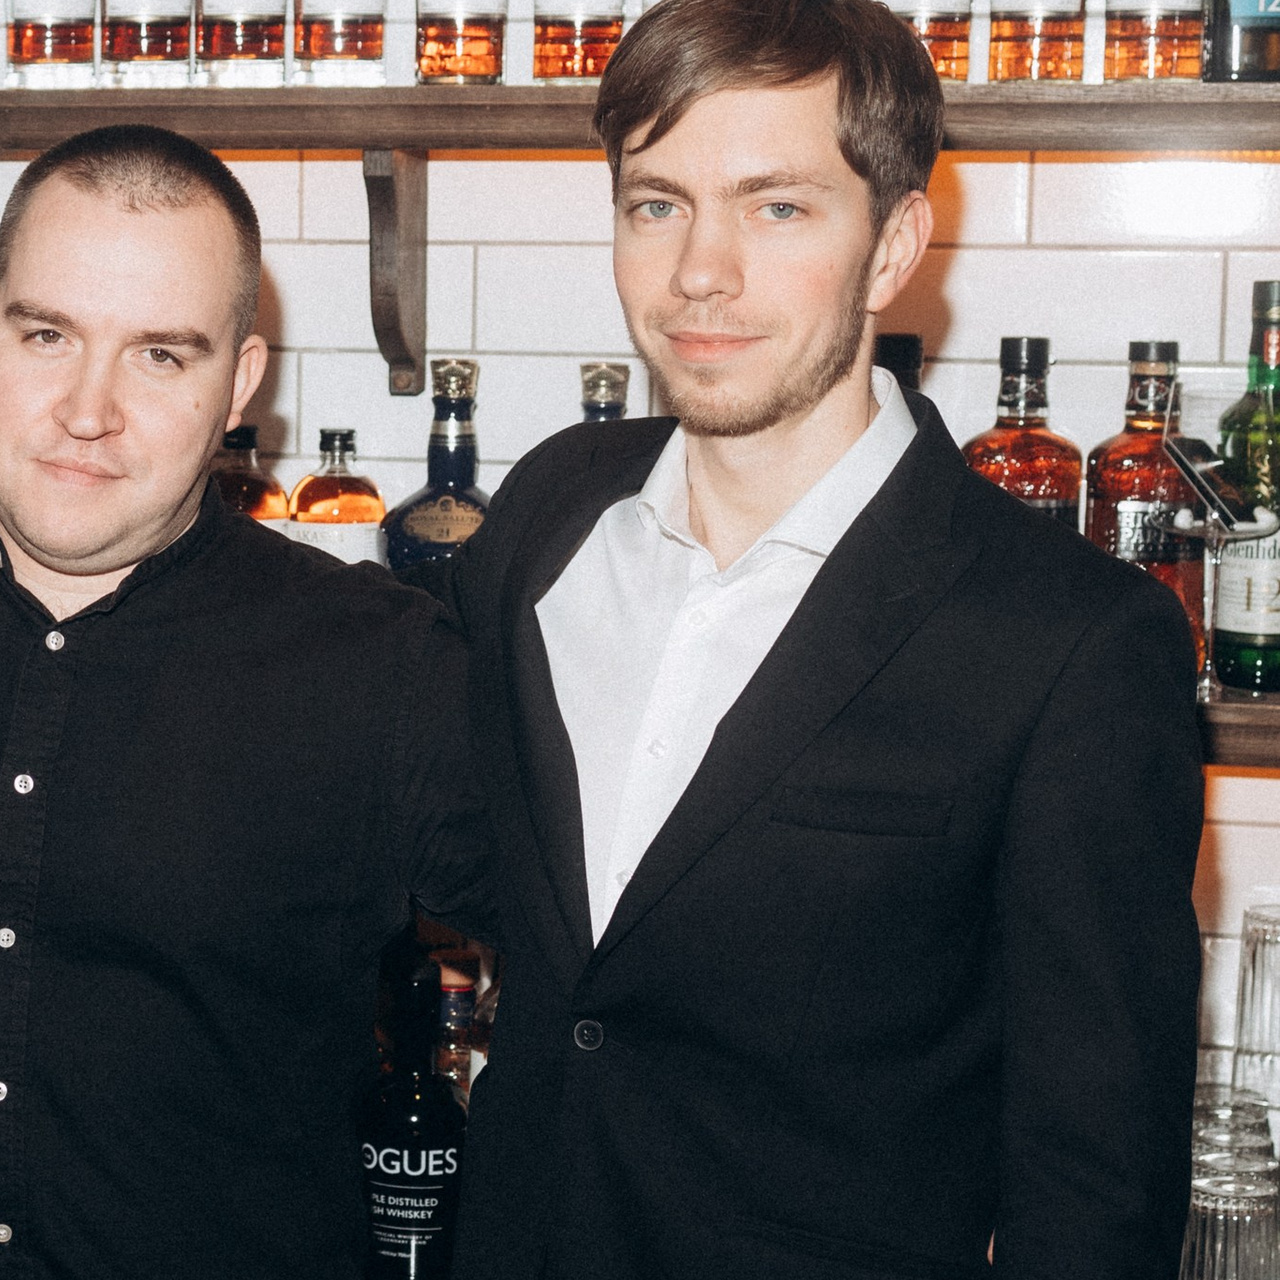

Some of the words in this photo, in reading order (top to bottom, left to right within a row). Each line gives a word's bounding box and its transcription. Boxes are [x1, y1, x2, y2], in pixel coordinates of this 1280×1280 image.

[362, 1143, 458, 1176] OGUES
[388, 1196, 439, 1207] DISTILLED
[386, 1208, 433, 1219] WHISKEY
